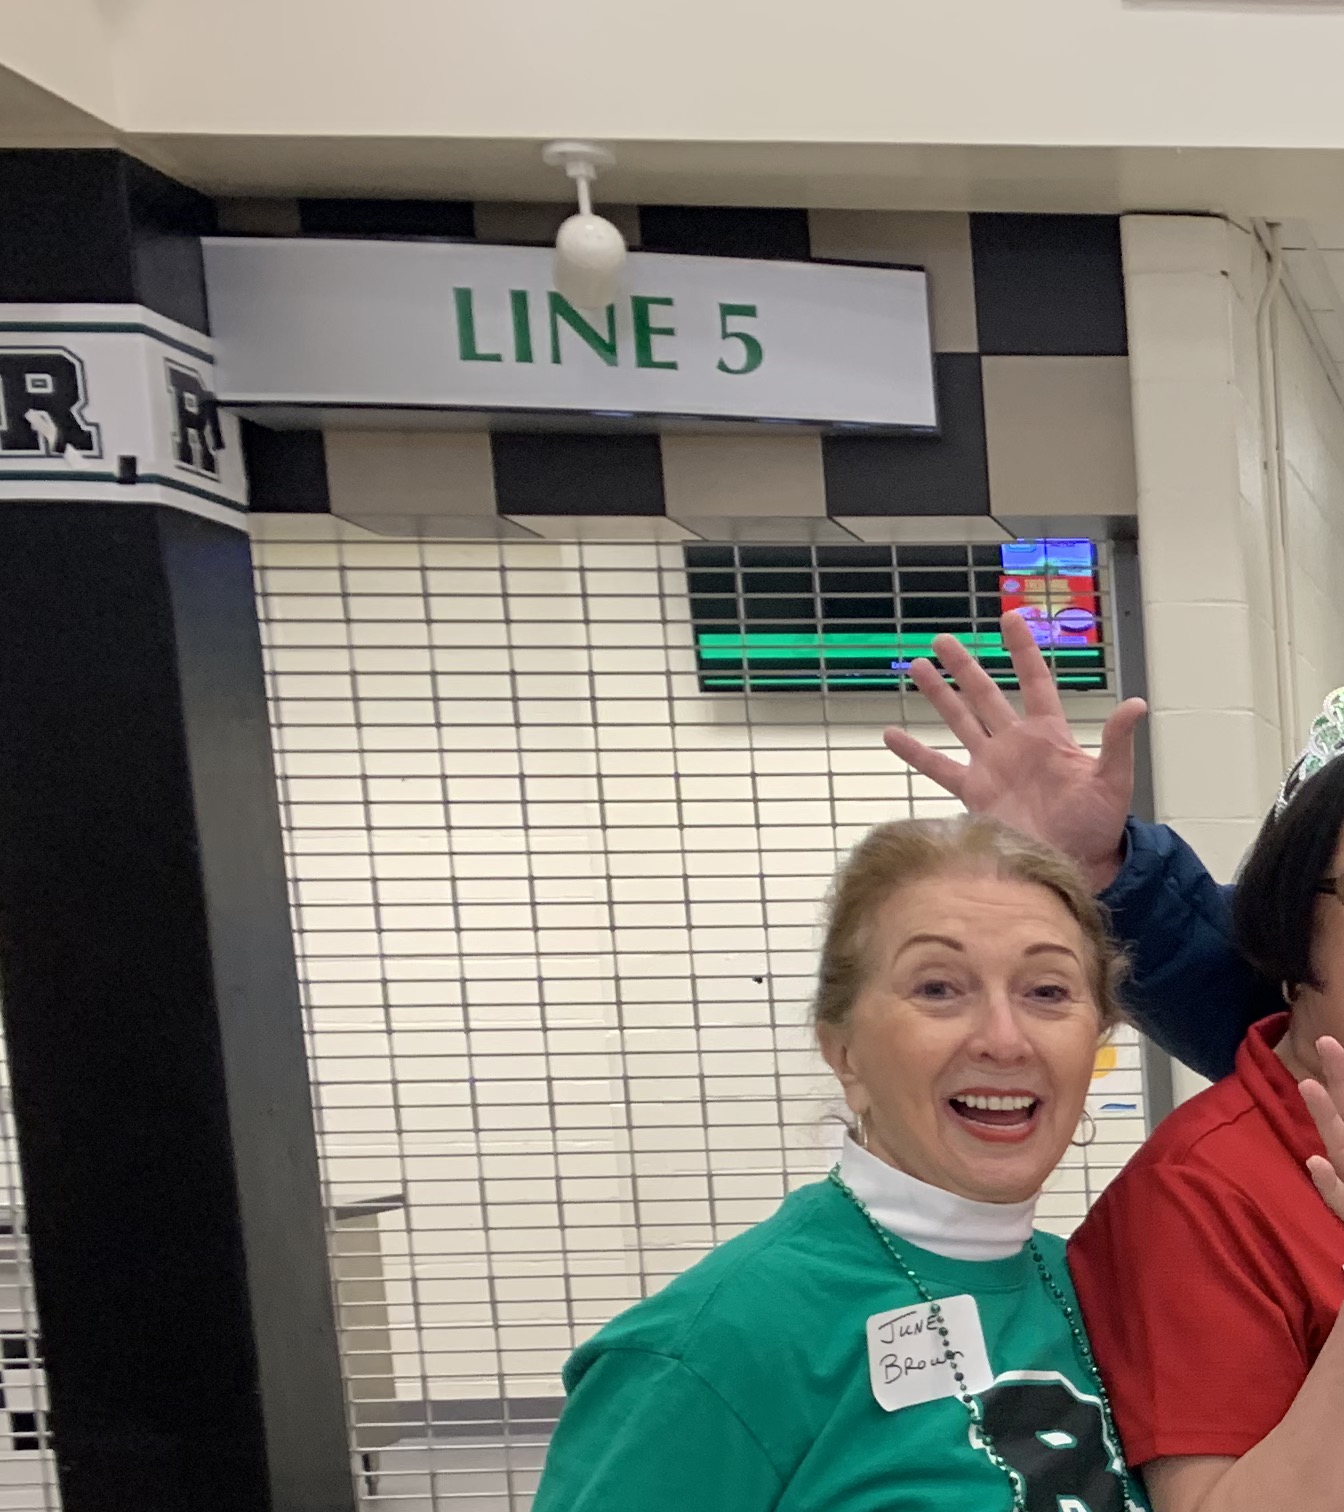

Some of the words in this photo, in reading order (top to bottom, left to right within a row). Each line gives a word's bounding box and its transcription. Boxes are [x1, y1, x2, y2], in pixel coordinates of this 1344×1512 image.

[452, 286, 679, 371] LINE
[715, 301, 764, 375] 5
[0, 345, 103, 459] R
[163, 356, 226, 483] R
